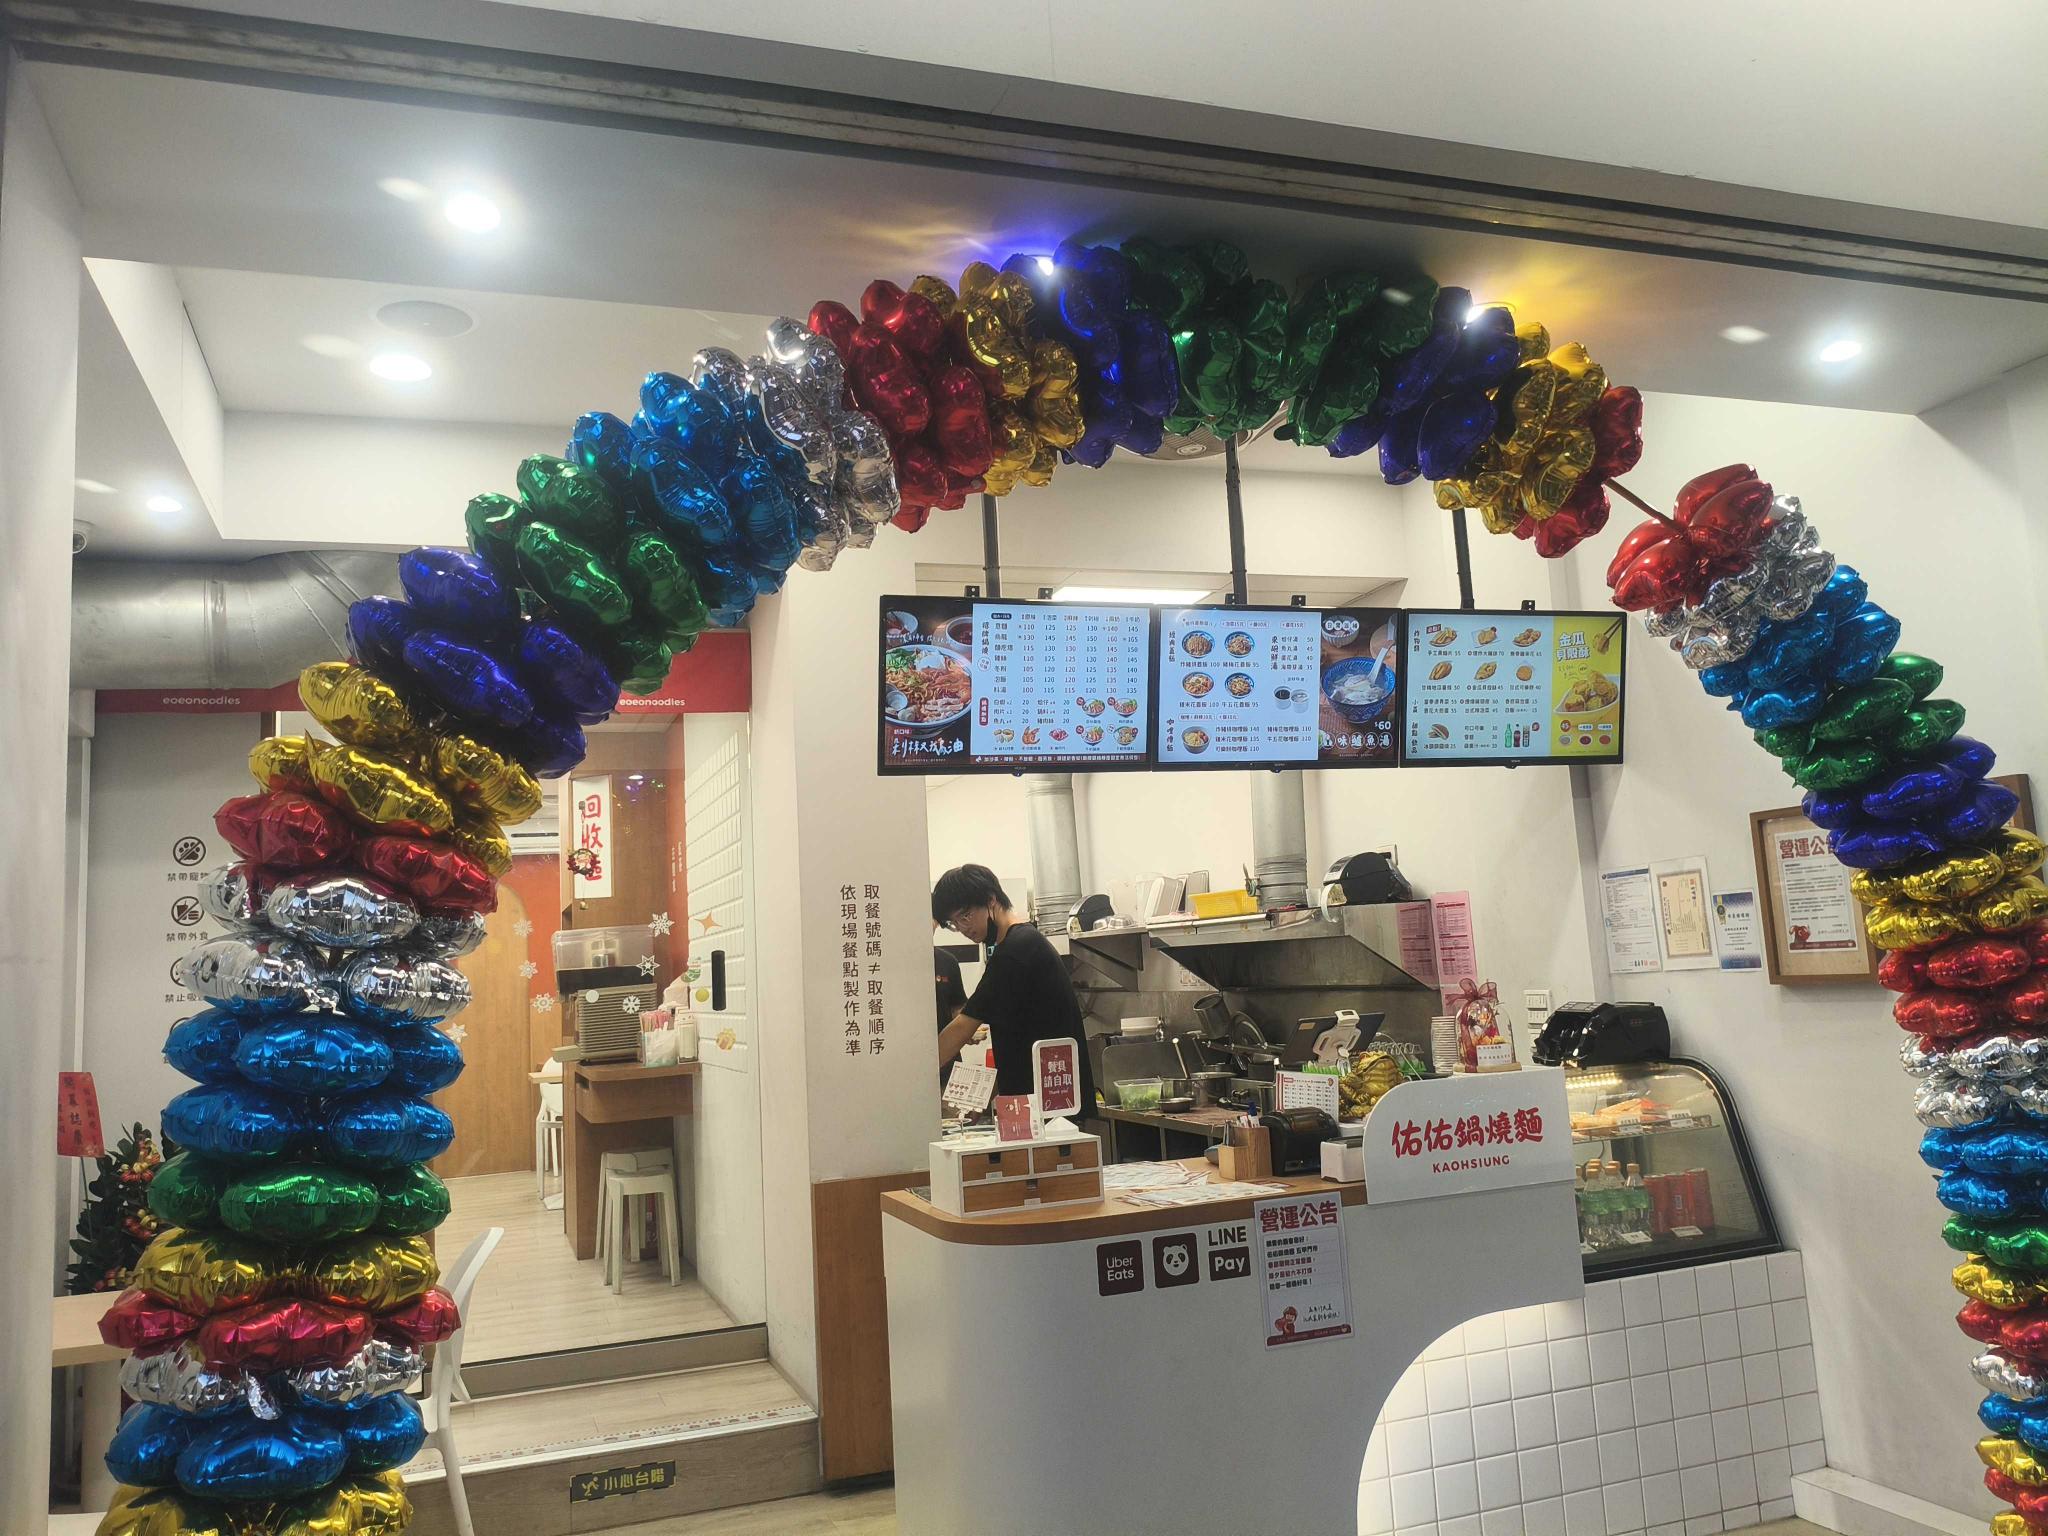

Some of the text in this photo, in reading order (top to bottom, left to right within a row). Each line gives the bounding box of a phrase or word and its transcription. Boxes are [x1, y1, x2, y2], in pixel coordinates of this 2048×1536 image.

[1559, 632, 1585, 647] 金瓜
[1556, 646, 1590, 662] 貝殼酥
[1375, 721, 1391, 730] $60
[166, 932, 208, 942] 禁帶外食
[840, 884, 861, 1057] 依現場餐點製作為準
[165, 994, 201, 1004] 禁止吸
[1044, 1074, 1072, 1088] 請自取
[1392, 1107, 1544, 1158] 佑佑鍋燒麵
[1432, 1155, 1510, 1174] KAOHSIUNG
[1260, 1200, 1338, 1233] 營運公告
[1208, 1226, 1246, 1246] LINE
[1106, 1256, 1134, 1269] Uber
[1214, 1256, 1246, 1272] Pay
[1107, 1268, 1134, 1281] Eats
[604, 1468, 664, 1490] 小心台階
